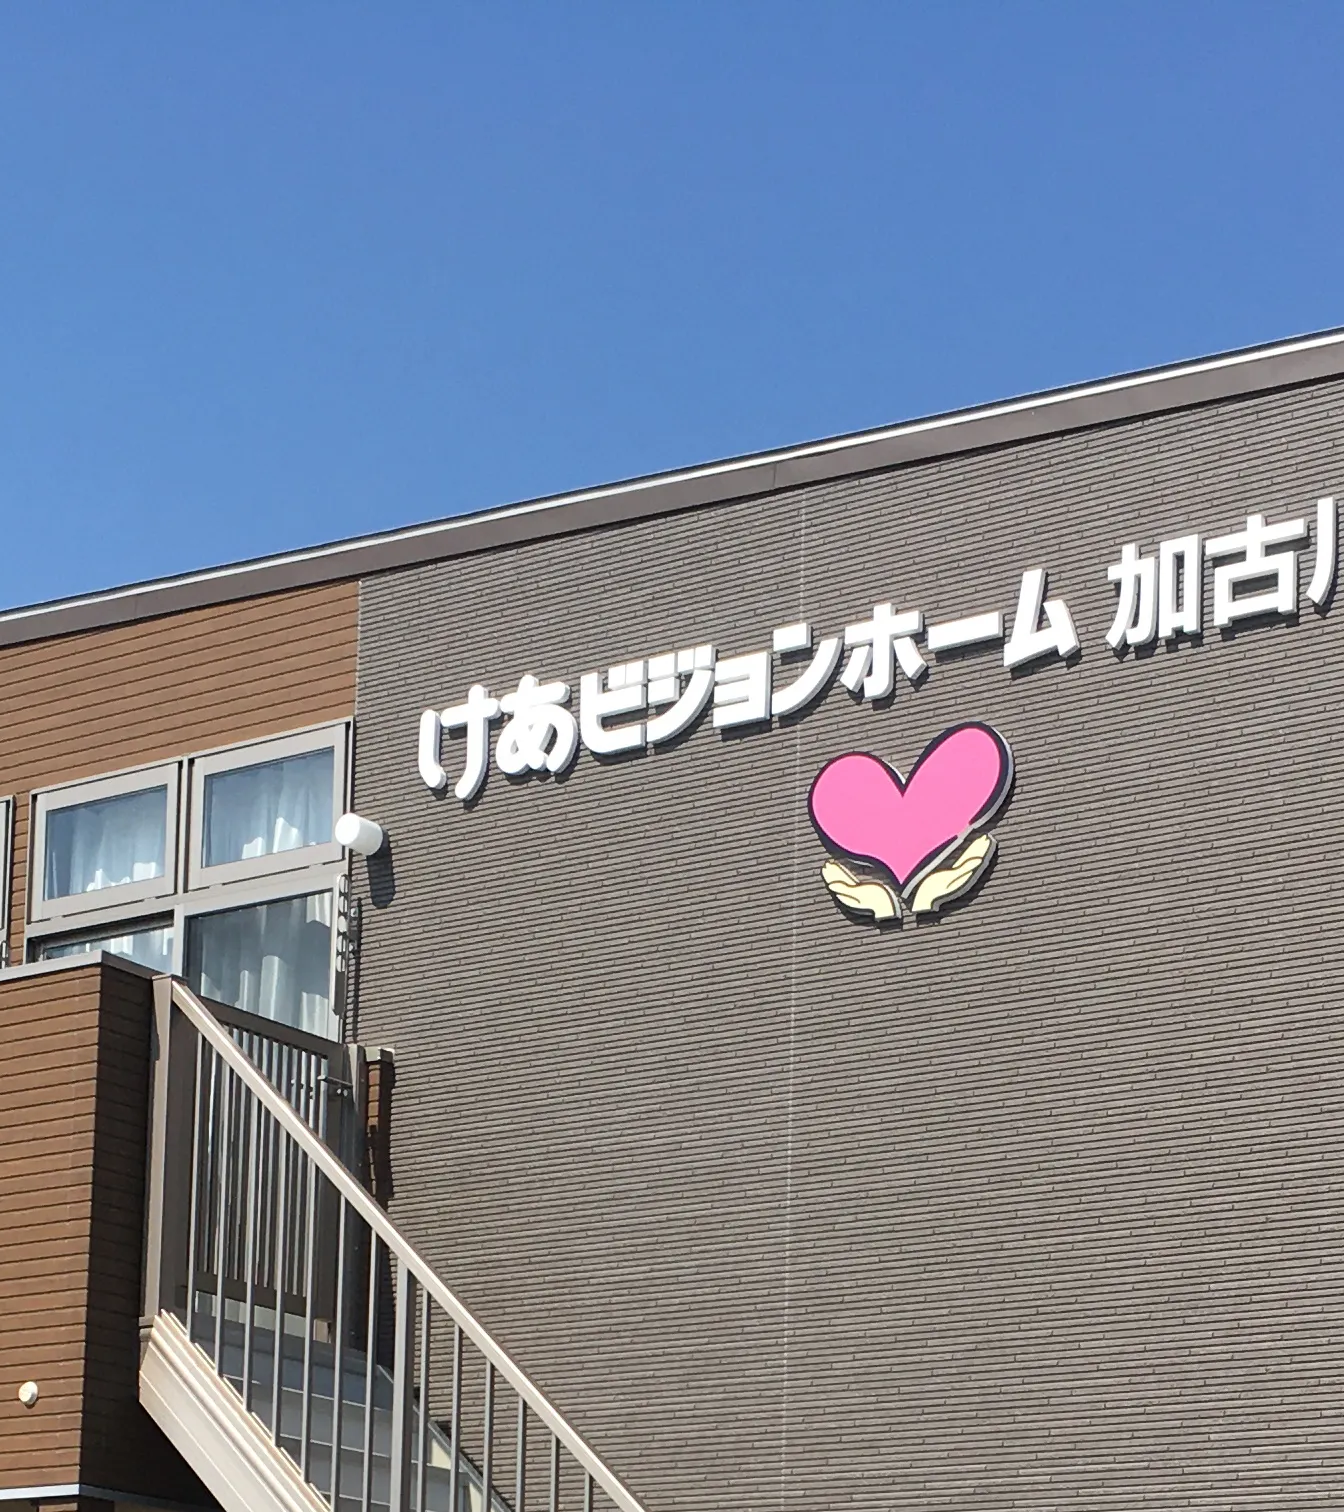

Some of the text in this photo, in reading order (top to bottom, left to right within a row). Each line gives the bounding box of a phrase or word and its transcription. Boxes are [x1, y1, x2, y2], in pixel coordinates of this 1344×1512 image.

[418, 568, 1080, 801] けあビジョンホーム
